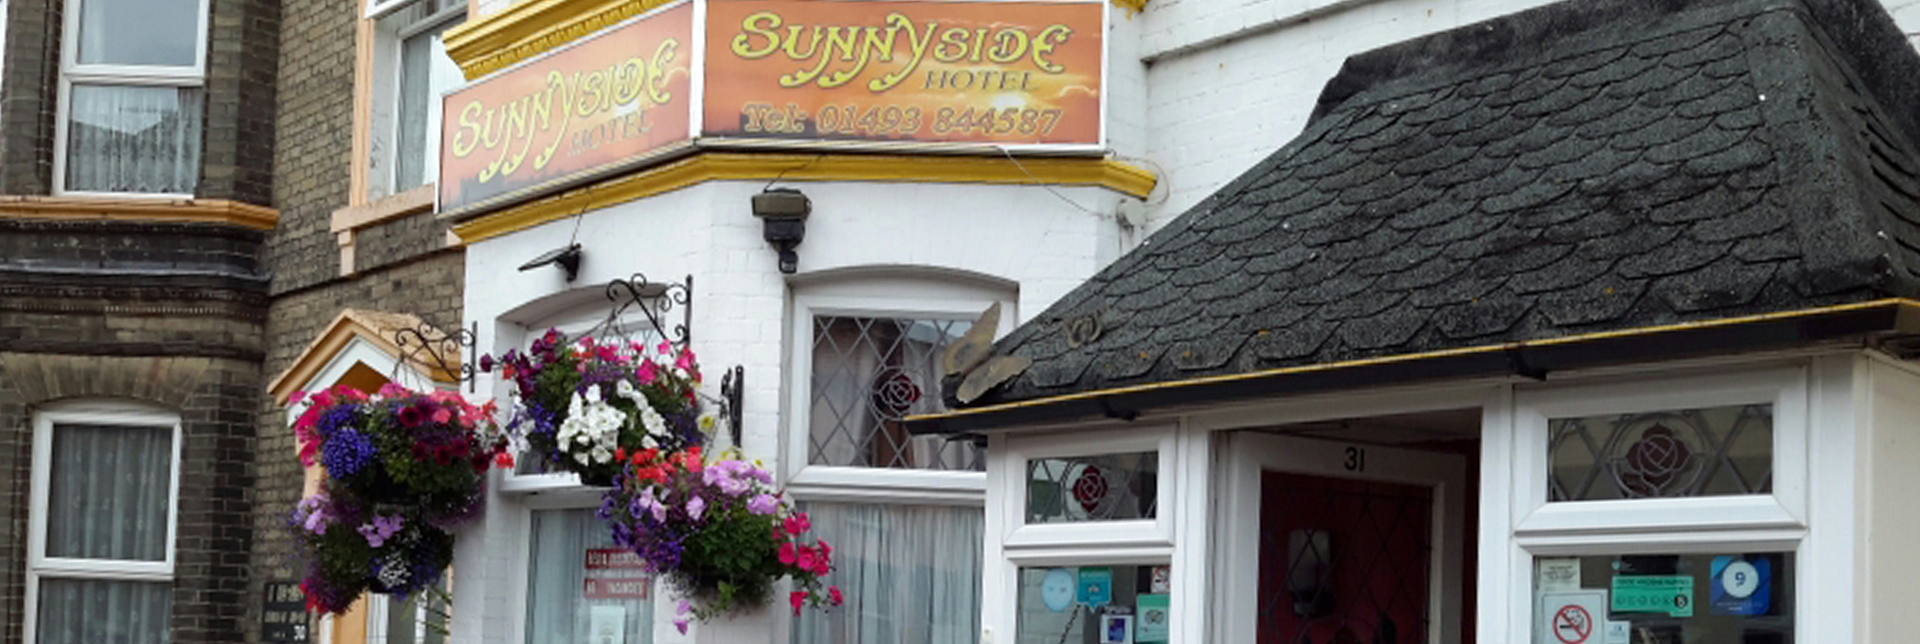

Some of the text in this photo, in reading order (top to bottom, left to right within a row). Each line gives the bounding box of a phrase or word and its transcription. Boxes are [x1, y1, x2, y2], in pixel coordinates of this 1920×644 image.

[731, 12, 1072, 92] SUNNYSIDE
[922, 70, 1041, 92] HOTEL
[452, 37, 679, 183] SUNNYSIDE
[815, 104, 922, 134] 01493
[932, 105, 1063, 135] 844587
[568, 109, 654, 157] HOTEL
[1344, 446, 1365, 472] 31
[1734, 571, 1746, 588] 9
